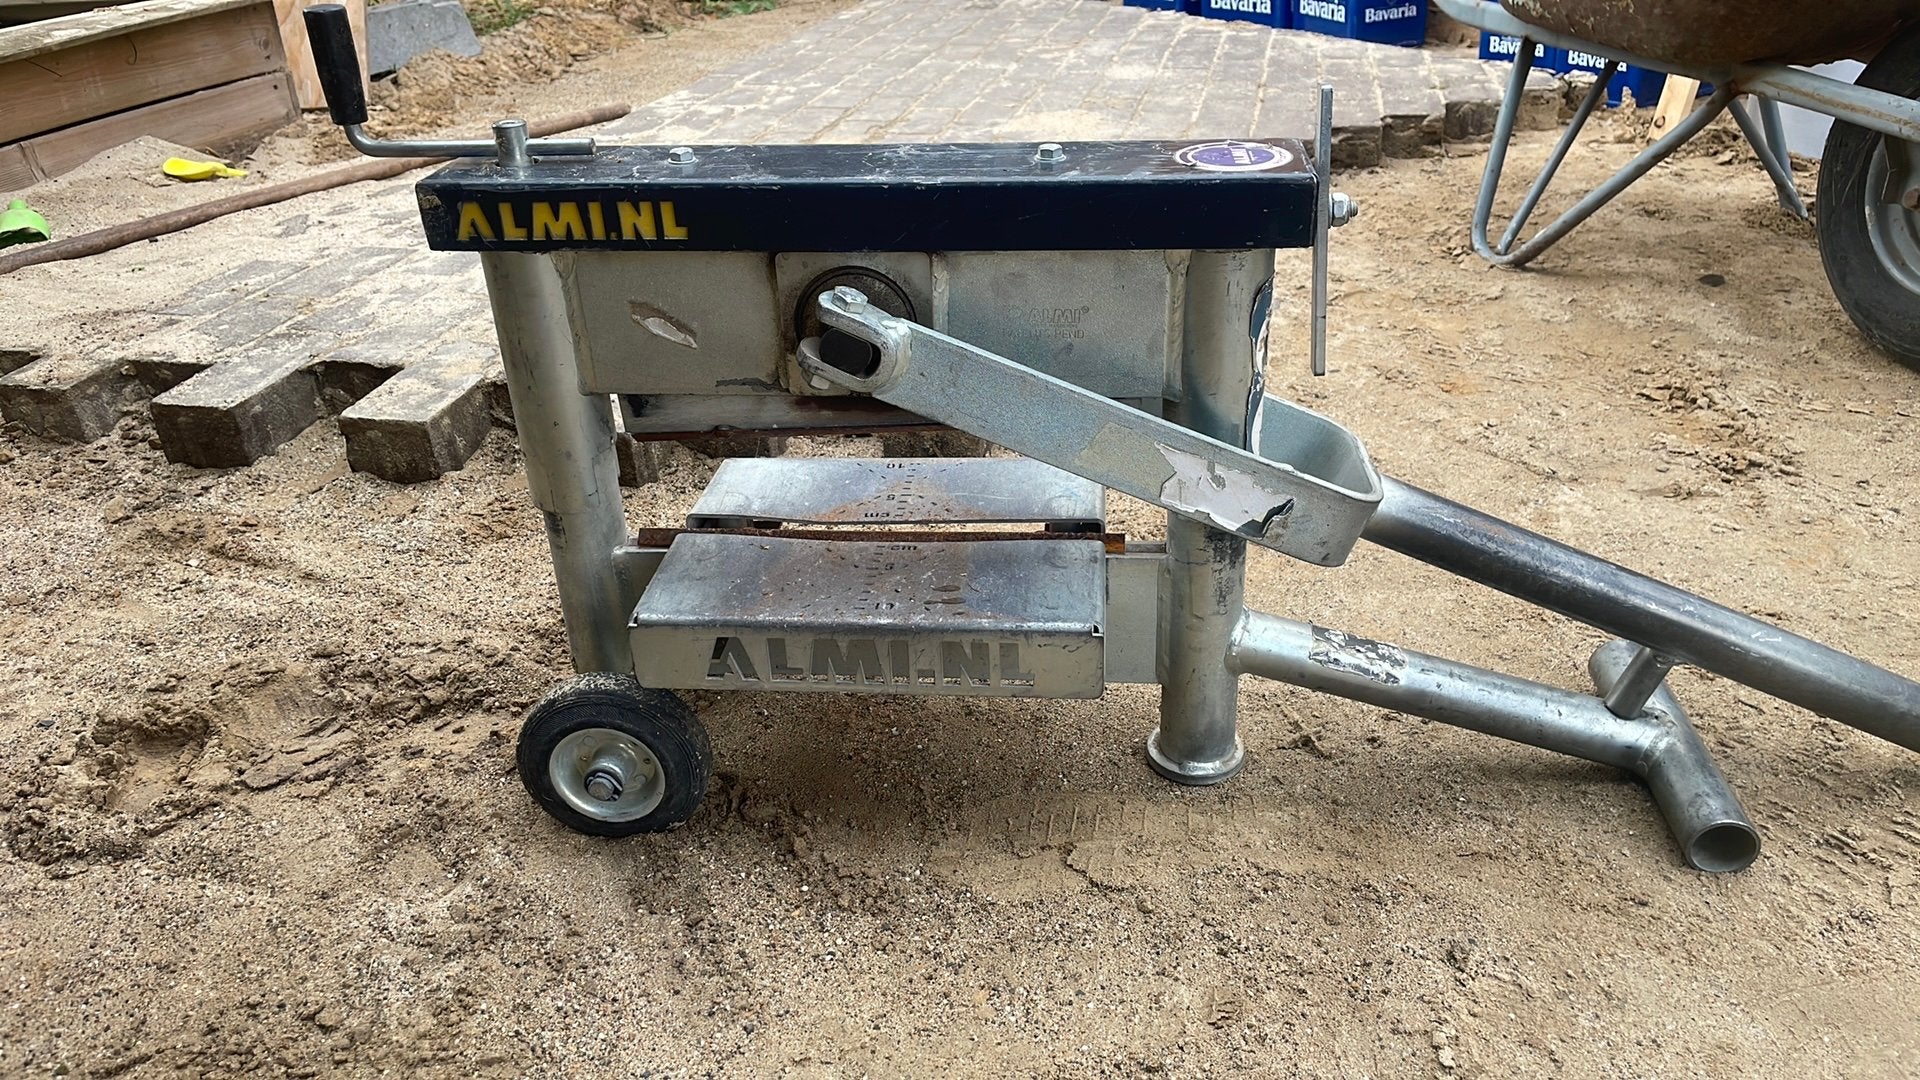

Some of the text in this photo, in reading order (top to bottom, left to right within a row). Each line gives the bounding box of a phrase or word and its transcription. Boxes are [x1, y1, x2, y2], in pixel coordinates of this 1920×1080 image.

[1299, 0, 1345, 23] Bavaria
[1364, 3, 1417, 24] Bavaria
[1567, 50, 1628, 72] Bavaa
[456, 201, 688, 241] ALMI.NL
[705, 636, 1034, 687] ALMI.NL
